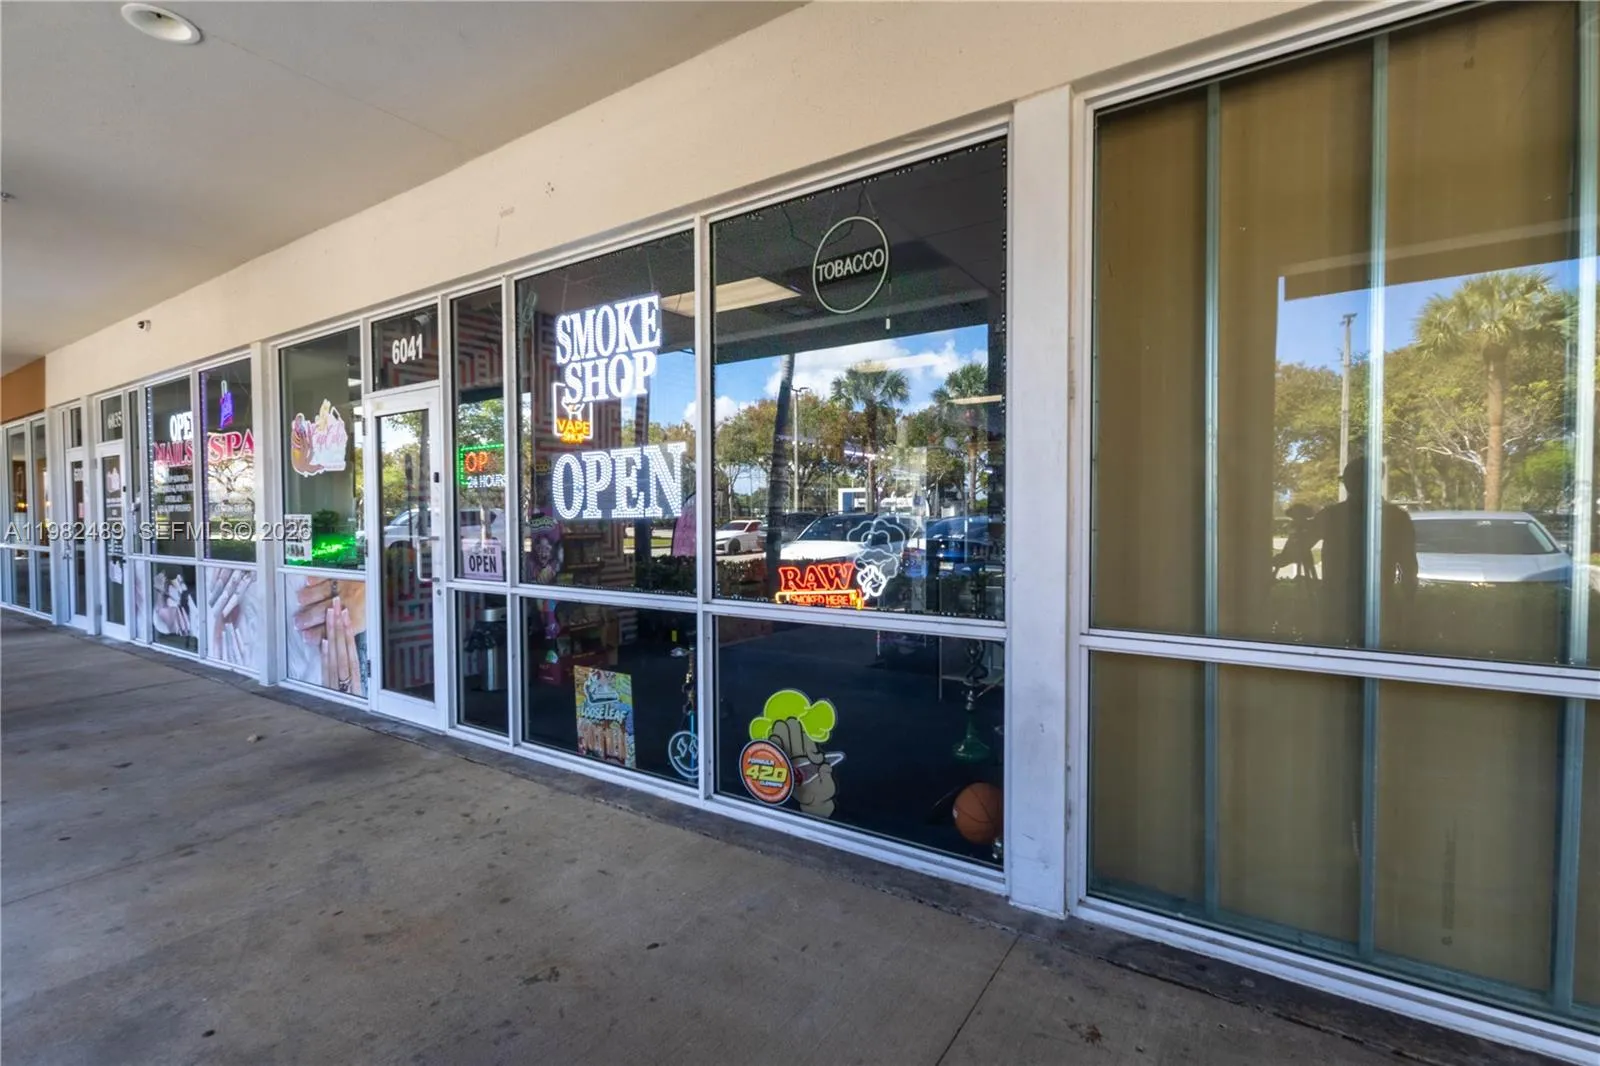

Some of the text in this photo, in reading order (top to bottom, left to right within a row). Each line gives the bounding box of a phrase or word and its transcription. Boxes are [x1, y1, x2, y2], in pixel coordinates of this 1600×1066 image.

[816, 248, 885, 282] TOBACCO
[556, 294, 662, 366] SMOKE
[392, 333, 423, 365] 6041
[564, 350, 656, 404] SHOP
[169, 411, 193, 442] OPE
[557, 418, 591, 436] VAPE
[153, 428, 254, 467] NAILS SPA
[552, 442, 687, 519] OPEN
[468, 555, 497, 574] OPEN
[778, 562, 855, 593] RAW
[746, 764, 788, 783] 420
